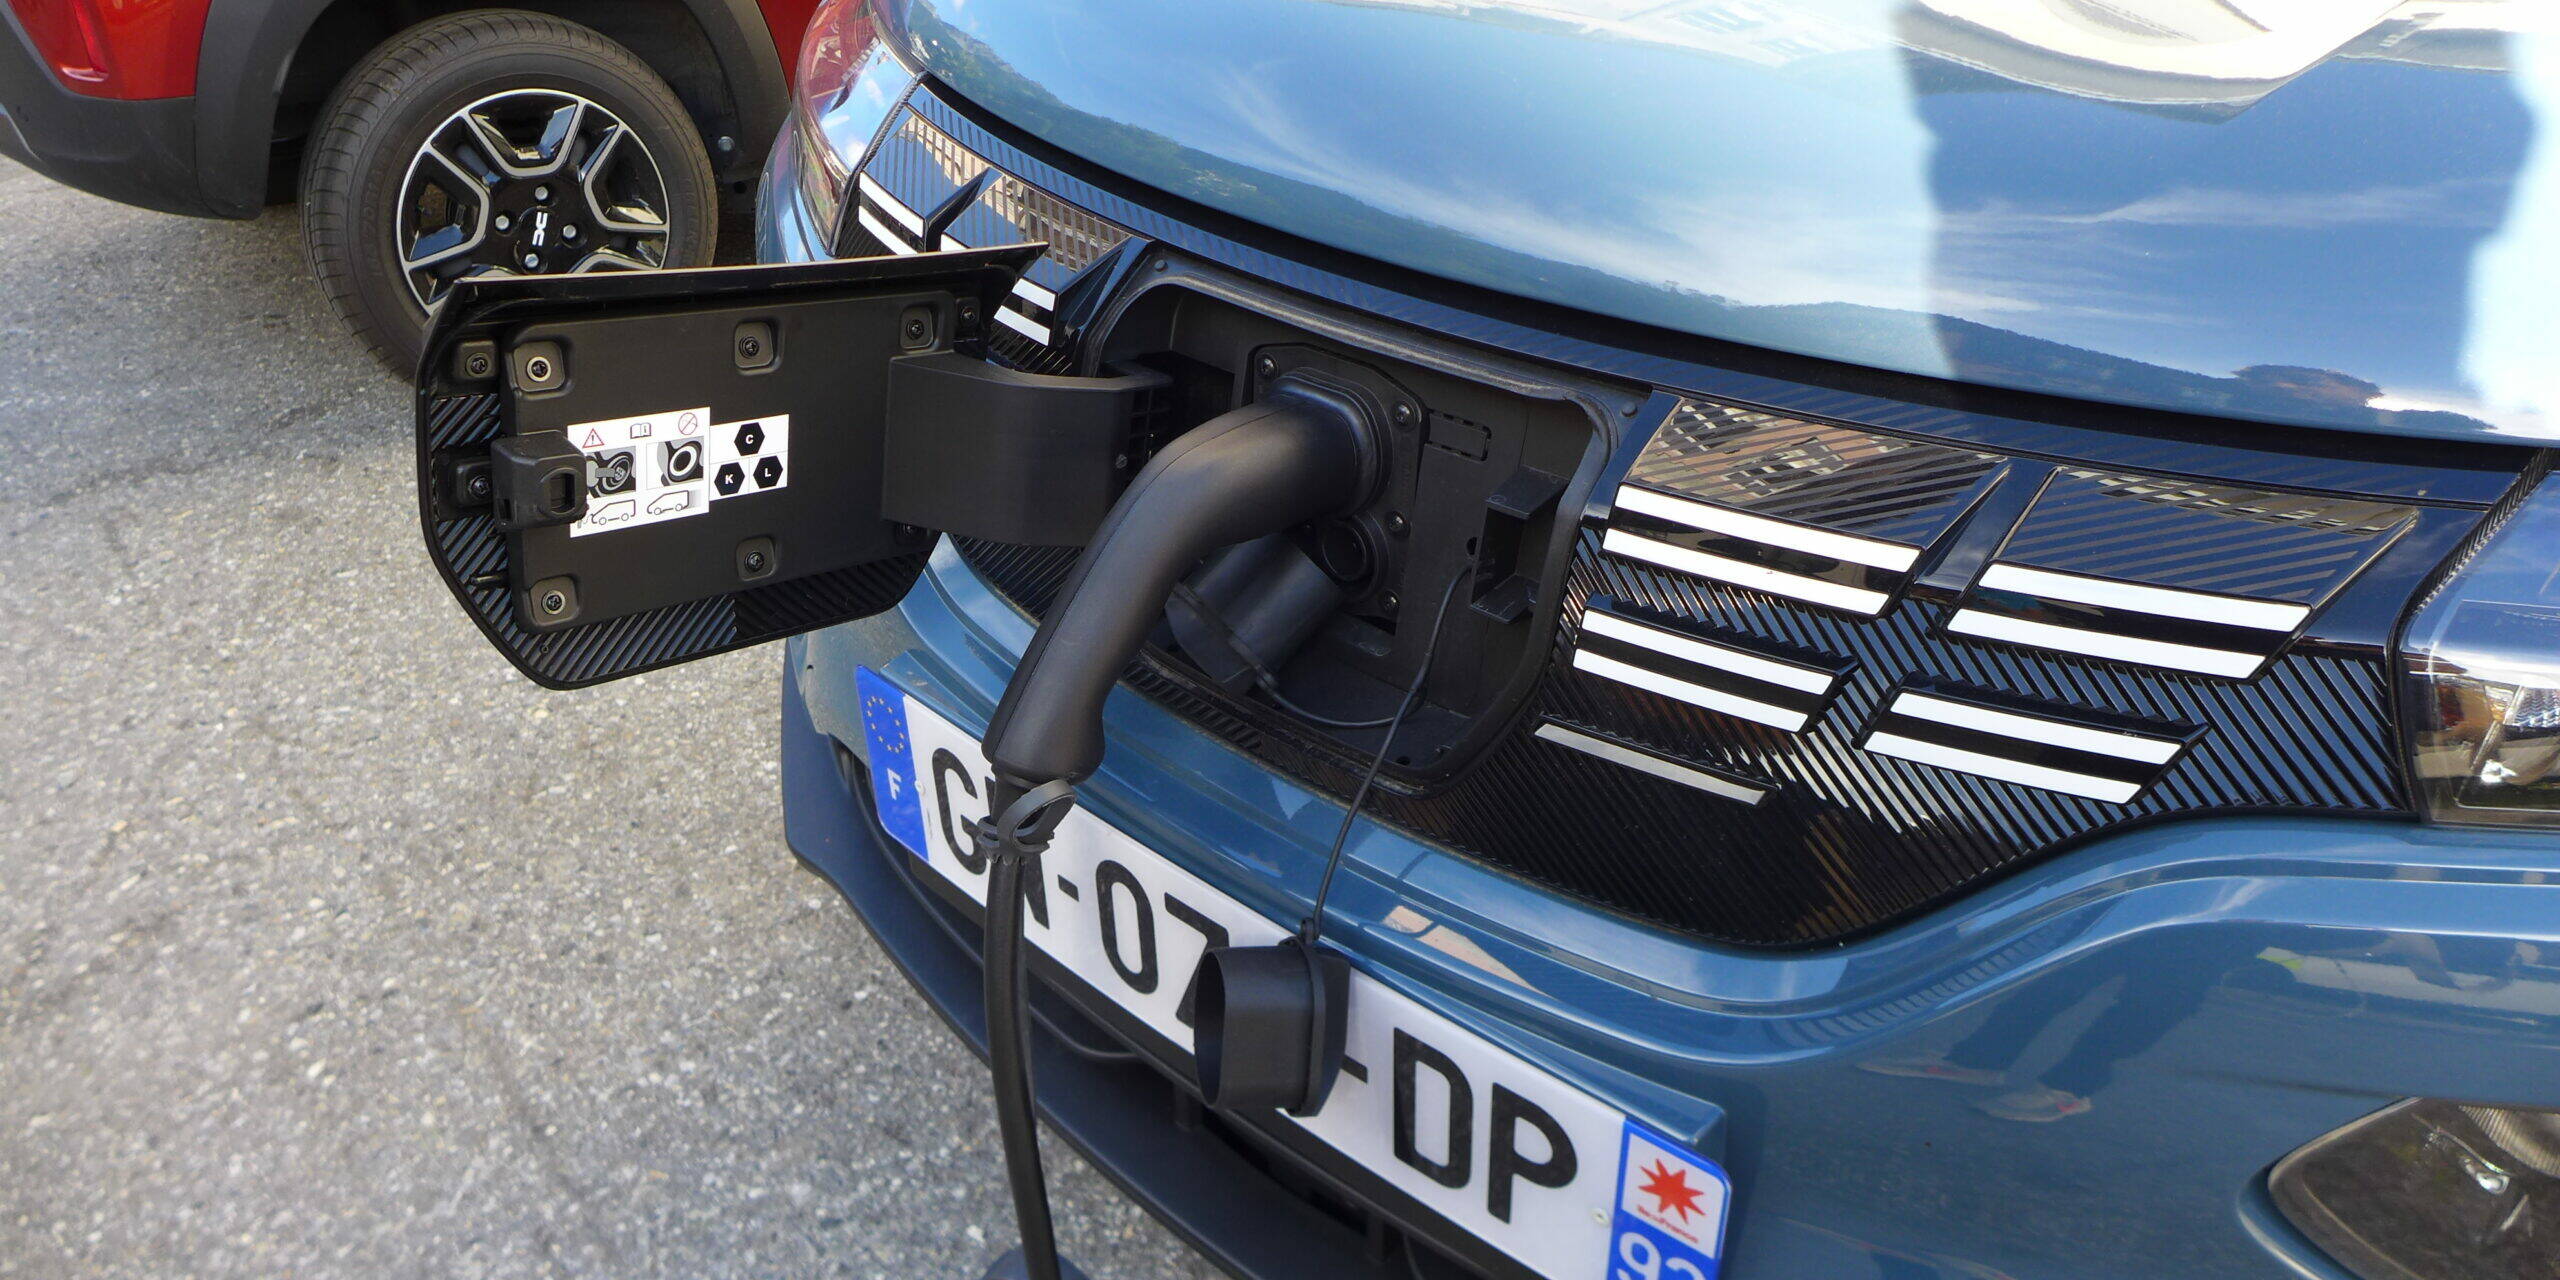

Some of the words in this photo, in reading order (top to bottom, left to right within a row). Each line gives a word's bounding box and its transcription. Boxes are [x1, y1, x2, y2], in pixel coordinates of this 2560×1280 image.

[745, 434, 754, 444] C
[725, 475, 734, 485] K
[764, 468, 772, 477] L
[887, 768, 902, 800] F
